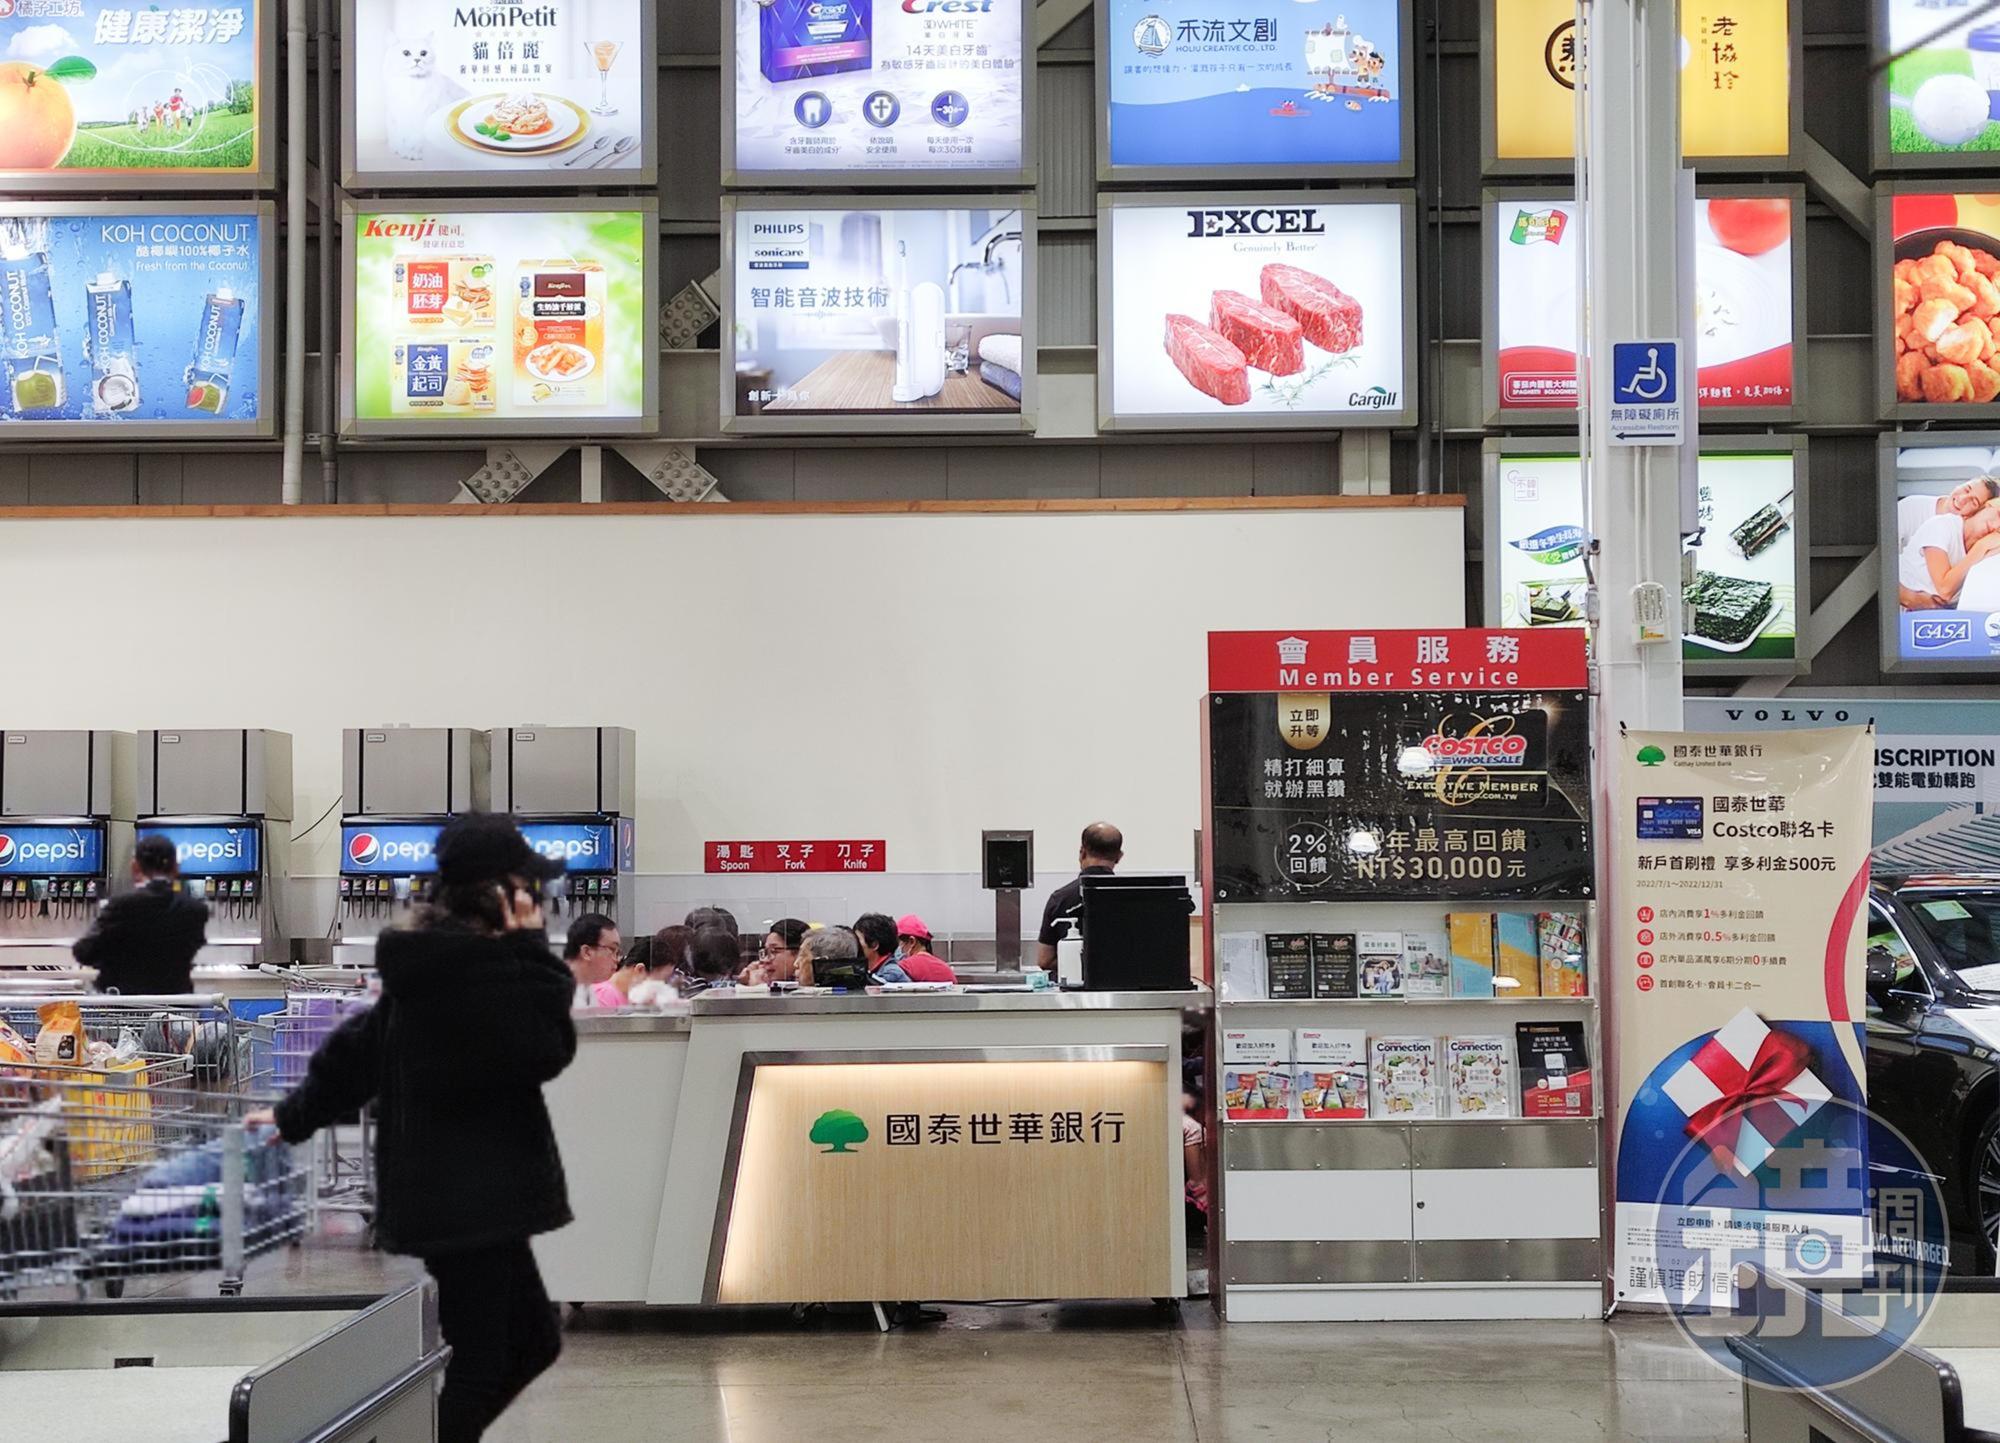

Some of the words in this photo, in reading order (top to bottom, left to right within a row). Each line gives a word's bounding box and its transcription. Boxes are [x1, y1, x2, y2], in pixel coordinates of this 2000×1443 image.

[94, 8, 244, 44] 健康潔淨
[1176, 18, 1277, 42] 禾流文創
[1203, 44, 1240, 52] CREATIVE
[363, 219, 436, 241] Kenji
[754, 224, 804, 234] PHILIPS
[1187, 209, 1325, 238] EXCEL
[102, 224, 145, 243] KOH
[150, 223, 249, 243] COCONUT
[754, 247, 804, 257] sonicare
[1233, 241, 1282, 252] Genuinely
[1286, 241, 1316, 252] Better
[165, 261, 187, 271] from
[412, 273, 443, 288] 奶油
[6, 270, 25, 331] COCONUT
[412, 293, 443, 310] 胚芽
[751, 287, 888, 308] 智能音波技術
[95, 293, 109, 346] COCONUT
[411, 355, 443, 371] 金黃
[411, 375, 443, 392] 起司
[1349, 392, 1397, 409] Cargill
[1611, 408, 1679, 421] 無障礙廁所
[1916, 623, 1967, 639] CASA
[1276, 636, 1519, 665] 會員服務
[1279, 668, 1394, 686] Member
[1411, 667, 1519, 686] Service
[1290, 709, 1319, 722] 立即
[1726, 710, 1849, 721] VOLVO
[1290, 725, 1319, 738] 升等
[1422, 735, 1526, 756] COSTCO
[1673, 745, 1763, 757] 國泰世華銀行
[1264, 758, 1345, 777] 精打細算
[1452, 756, 1522, 765] WHOLESALE
[1479, 781, 1539, 792] MEMBER
[1874, 771, 1976, 788] 雙能電動轎跑
[1264, 779, 1345, 798] 就辦黑鑽
[1712, 796, 1785, 813] 國泰世華
[1712, 820, 1835, 838] Costco聯名卡
[19, 838, 85, 862] pepsi
[176, 838, 242, 863] pepsi
[716, 844, 754, 858] 湯匙
[776, 844, 814, 858] 叉子
[837, 843, 874, 858] 刀子
[1289, 834, 1327, 854] 2%
[720, 860, 749, 871] Spoon
[785, 860, 806, 869] Fork
[843, 859, 868, 869] Knife
[1290, 857, 1328, 874] 回饋
[1637, 855, 1716, 871] 新戶首刷禮
[1724, 855, 1836, 871] 享多利金500元
[1376, 1043, 1431, 1052] Connection
[1450, 1042, 1503, 1051] Connection
[886, 1111, 1126, 1145] 國泰世華銀行
[1629, 1266, 1705, 1292] 謹慎理財
